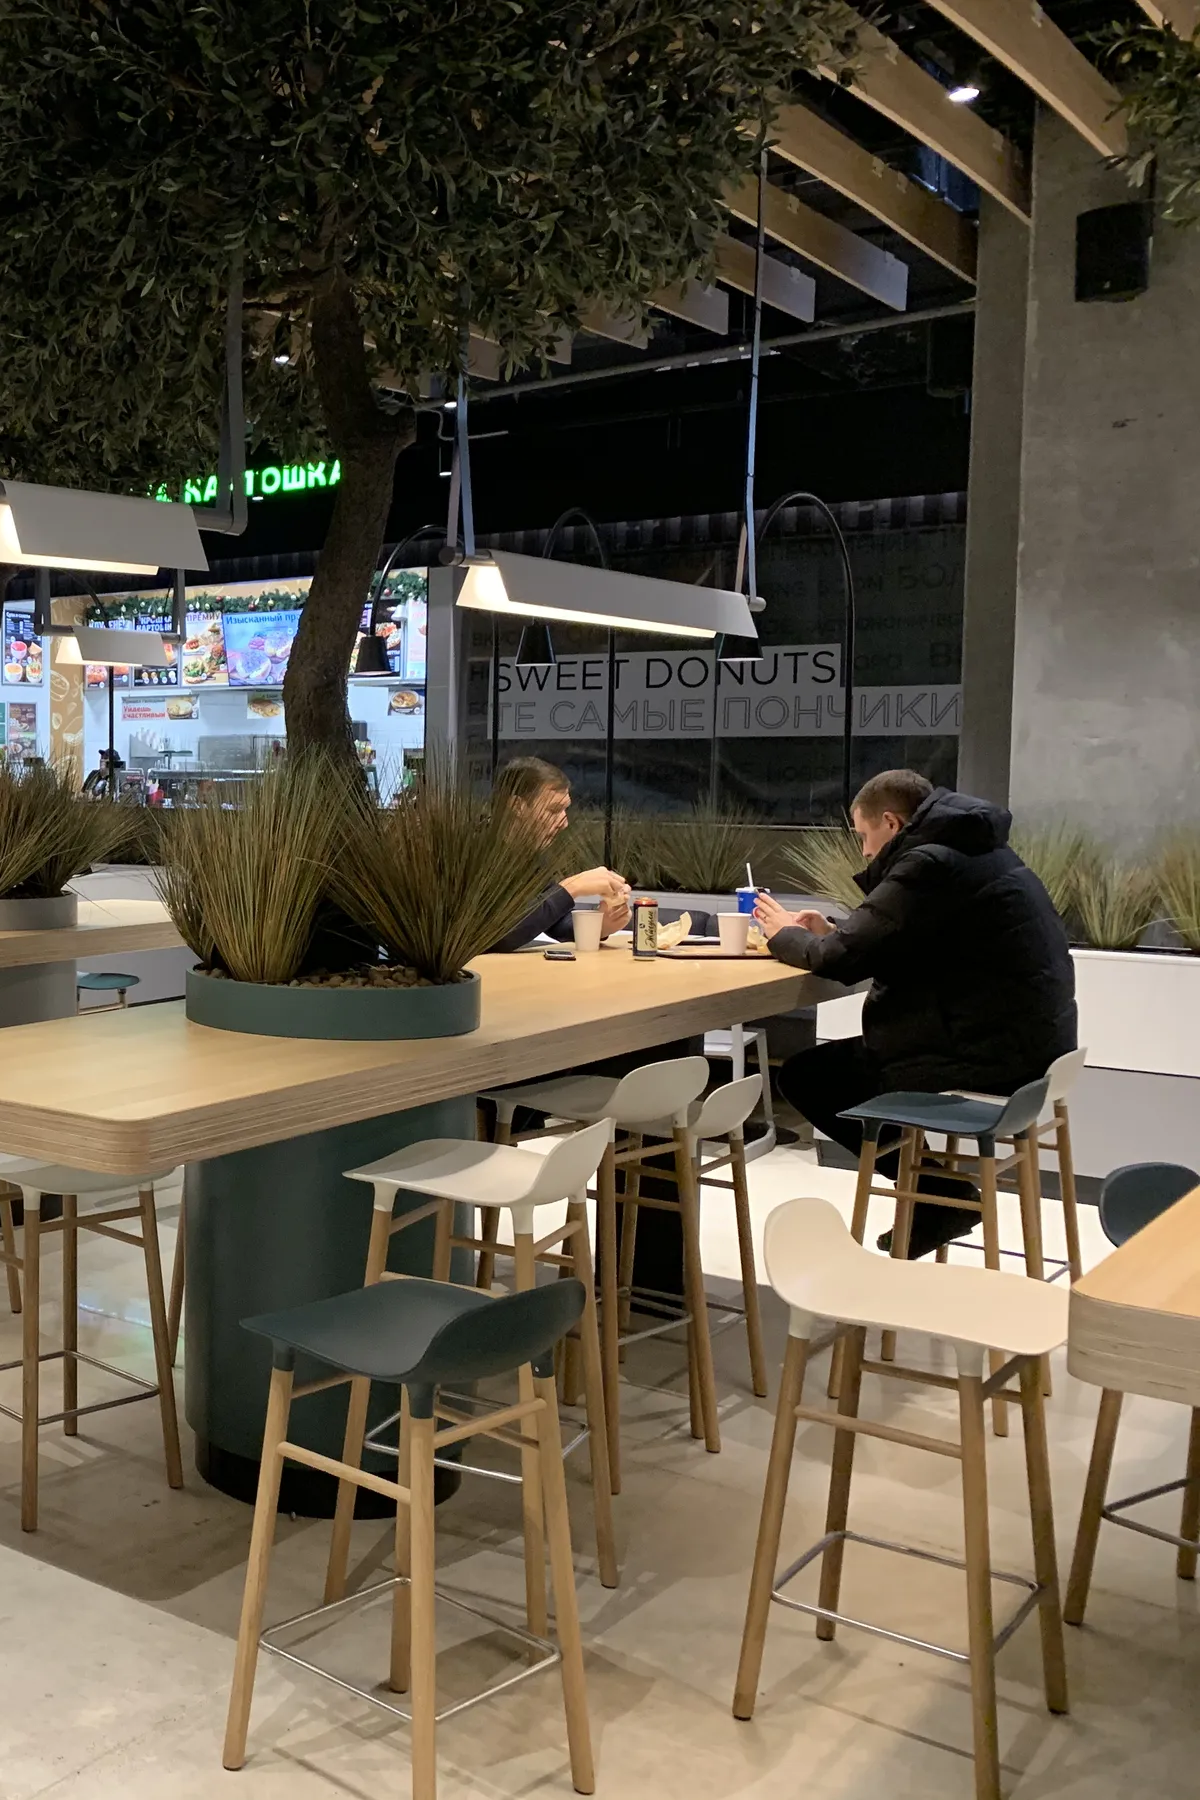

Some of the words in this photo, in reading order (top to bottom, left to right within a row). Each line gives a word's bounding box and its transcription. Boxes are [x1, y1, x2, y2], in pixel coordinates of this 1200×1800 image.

[496, 659, 630, 693] SWEET
[645, 650, 836, 689] DONUTS
[549, 699, 705, 733] САМЫЕ
[722, 692, 962, 730] ПОНЧИКИ
